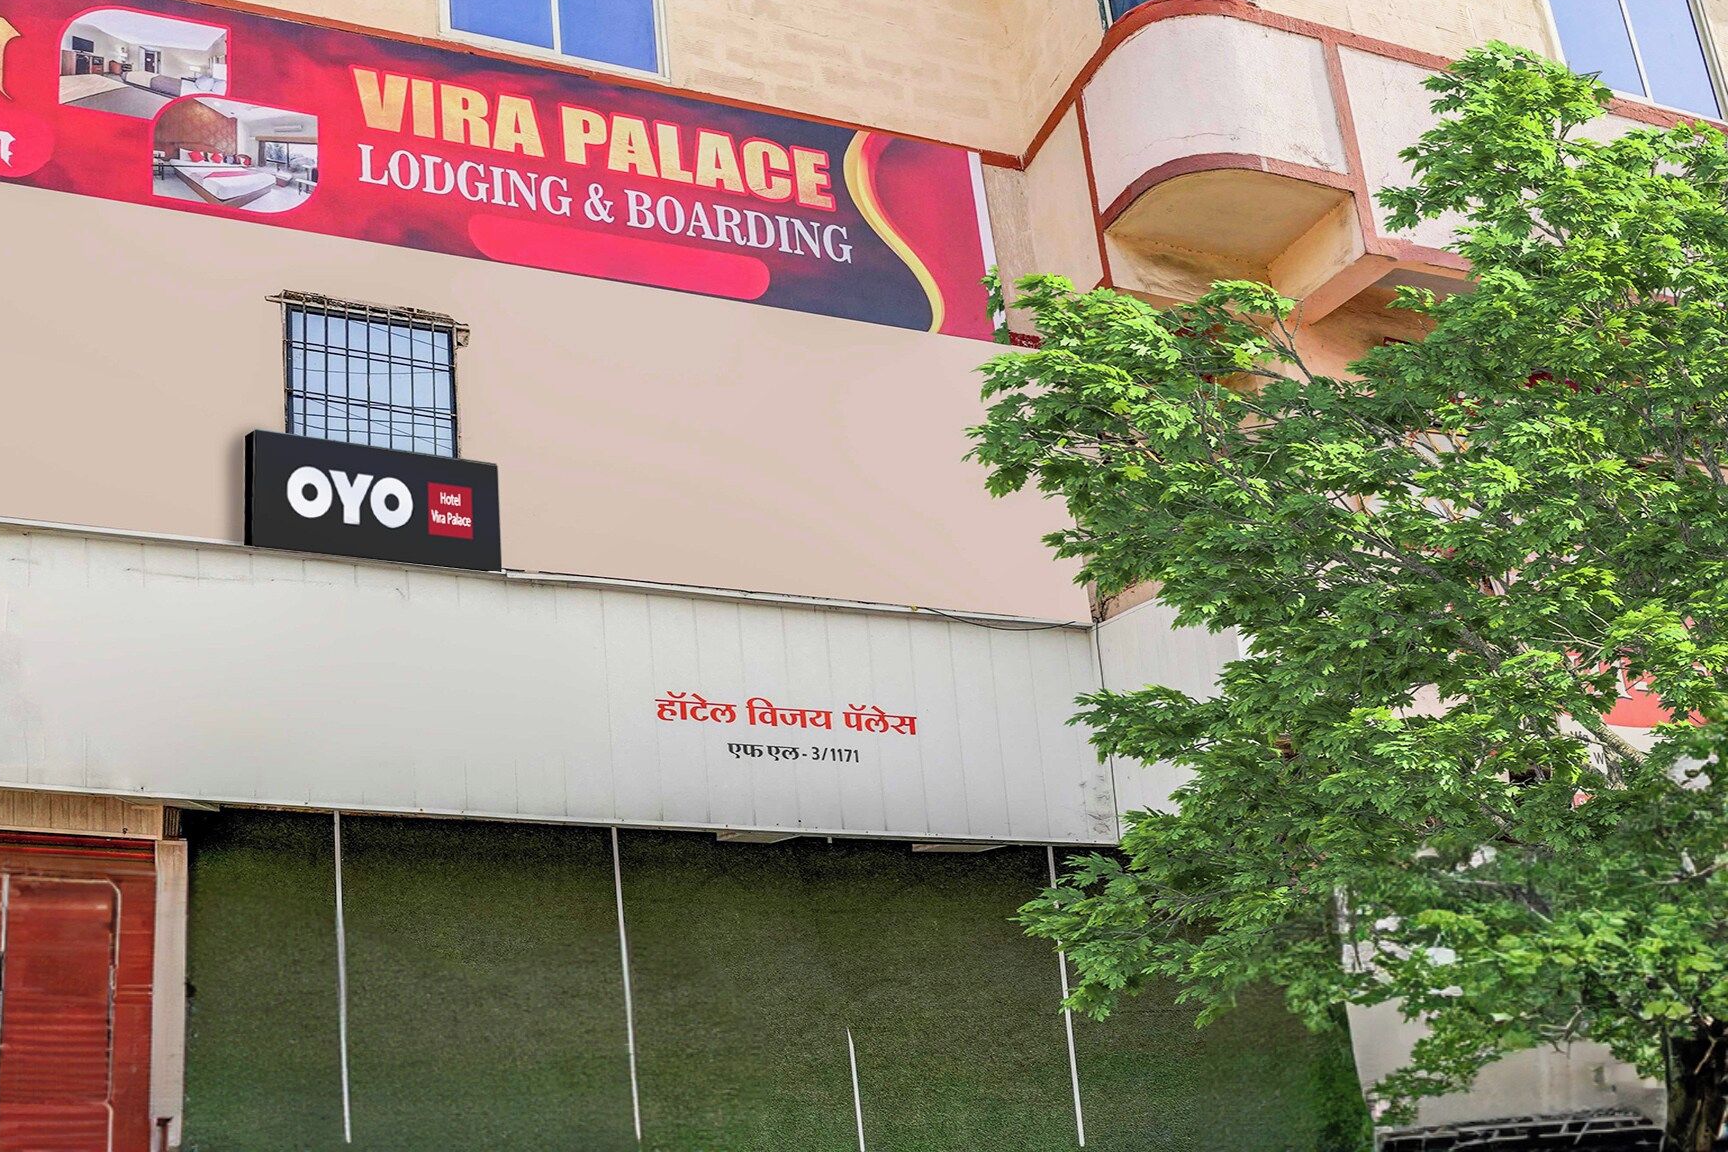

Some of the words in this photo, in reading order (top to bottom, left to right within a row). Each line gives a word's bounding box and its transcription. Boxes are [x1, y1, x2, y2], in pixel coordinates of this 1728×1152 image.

[349, 64, 545, 159] VIRA
[561, 104, 837, 212] PALACE
[357, 144, 574, 218] LODGING
[583, 183, 614, 223] &
[626, 190, 853, 265] BOARDING
[286, 465, 414, 529] OYO
[439, 491, 462, 507] Hotel
[446, 511, 472, 528] Palace
[654, 690, 737, 724] हॉटेल
[745, 696, 833, 730] विजय
[841, 703, 918, 736] पॅलेस
